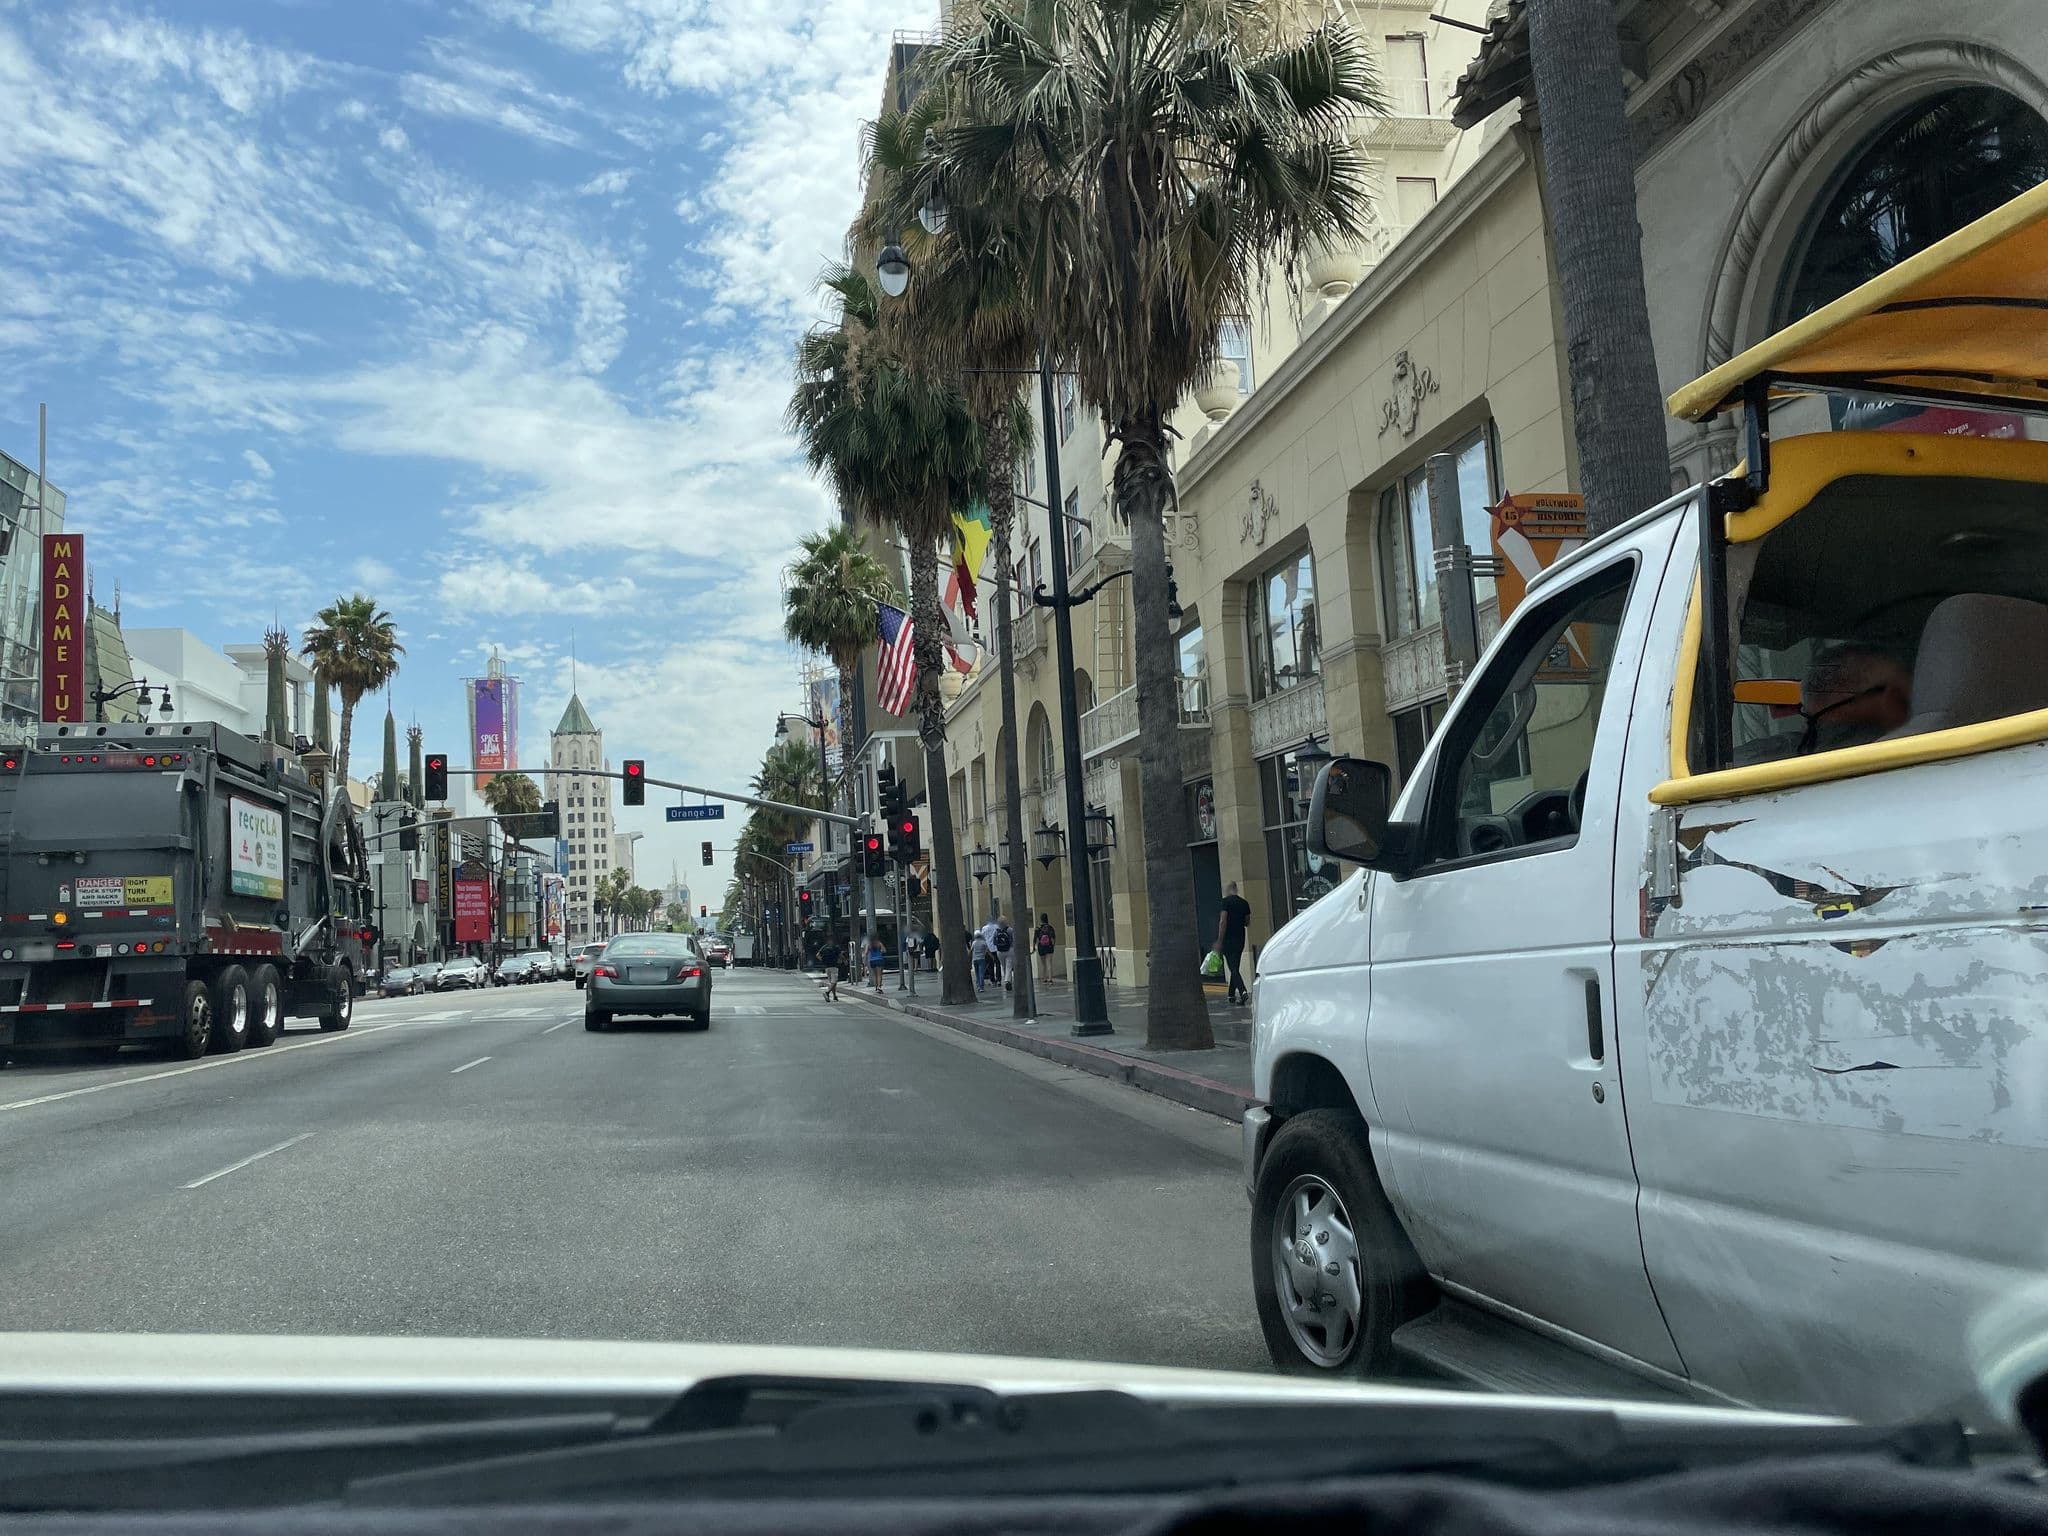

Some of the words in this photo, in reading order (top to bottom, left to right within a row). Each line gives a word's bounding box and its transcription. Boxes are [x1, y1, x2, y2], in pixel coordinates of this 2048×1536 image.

[1947, 422, 1969, 435] Vargas
[1536, 499, 1578, 508] HOLLYWOOD
[1505, 511, 1517, 520] 15
[1537, 512, 1578, 520] HISTORIC
[53, 541, 72, 662] MADAME
[481, 733, 499, 743] SPACE
[481, 740, 500, 754] JAM
[671, 809, 704, 818] Orange
[708, 808, 720, 816] Dr
[239, 810, 278, 838] recycLA
[438, 827, 449, 911] CHINESE
[79, 878, 121, 887] DANGER
